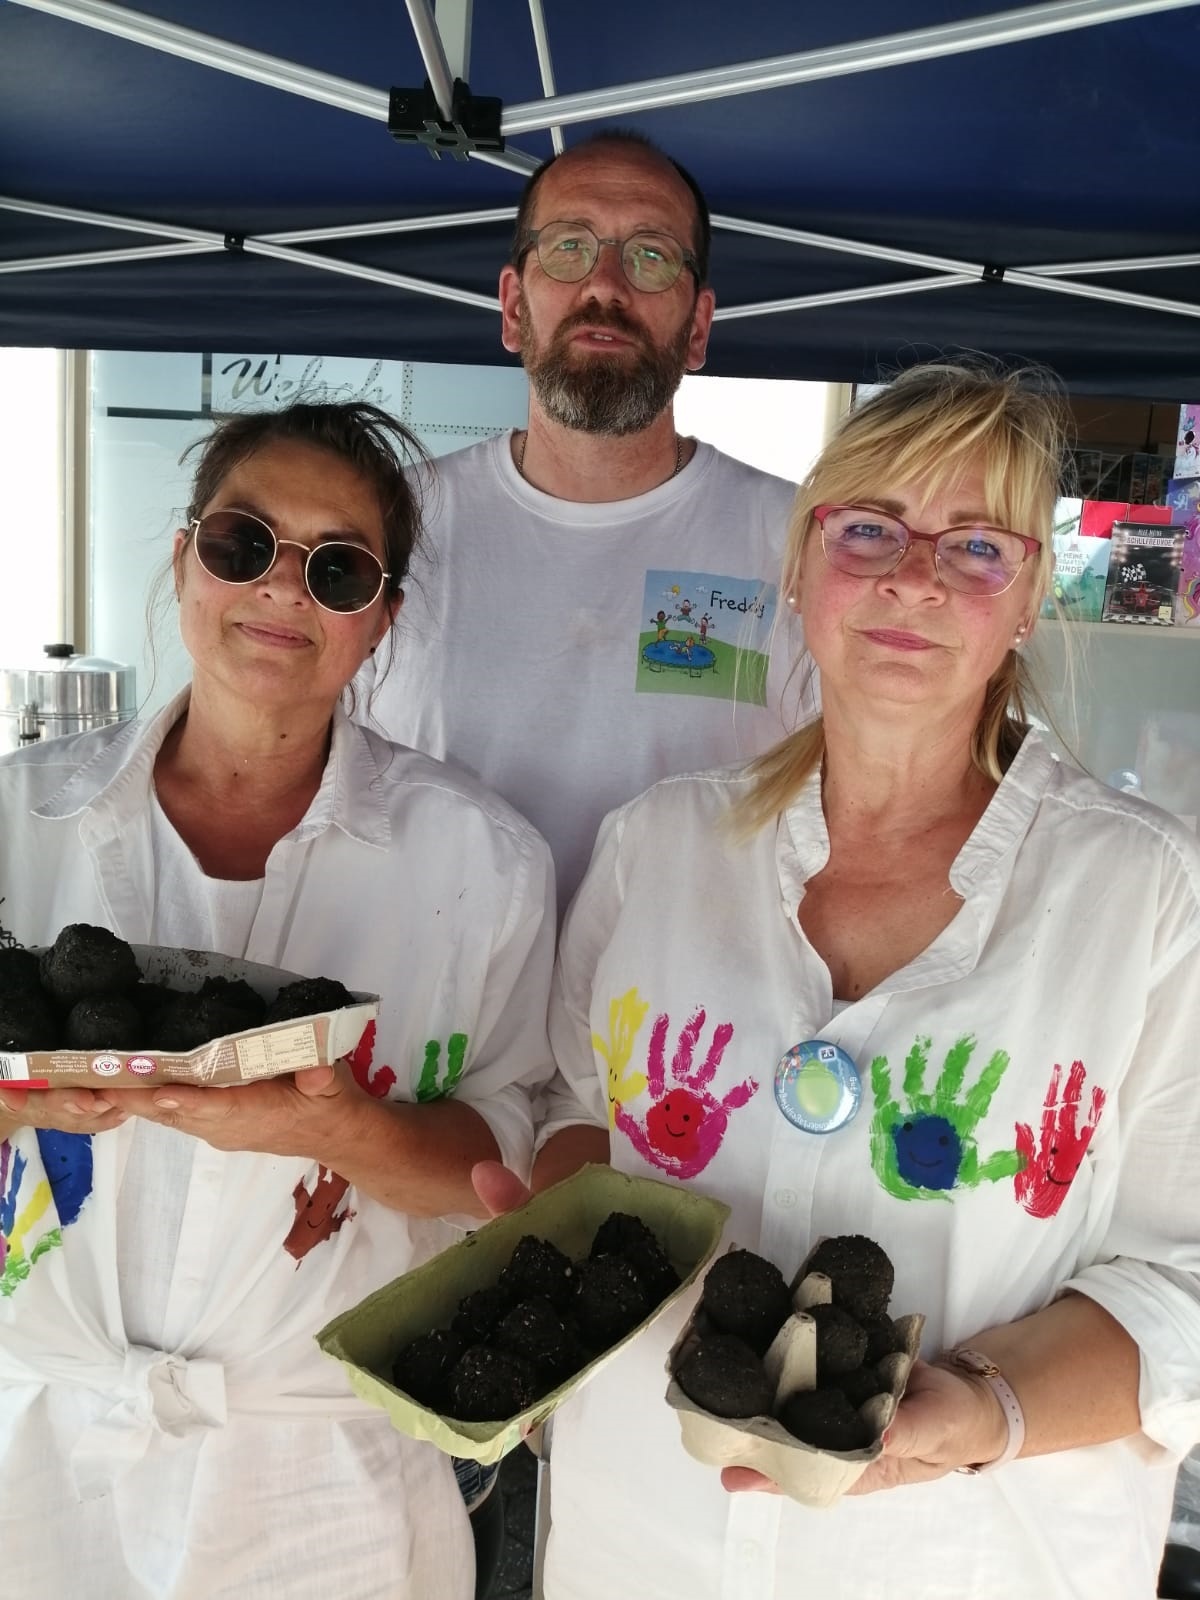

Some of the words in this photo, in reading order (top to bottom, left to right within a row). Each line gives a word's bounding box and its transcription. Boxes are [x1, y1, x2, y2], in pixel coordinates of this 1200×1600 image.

[1127, 538, 1173, 546] SCHULFREUNDE
[1055, 564, 1082, 575] EUNDE
[709, 590, 765, 618] Freddy
[778, 1088, 834, 1131] indertagespflege
